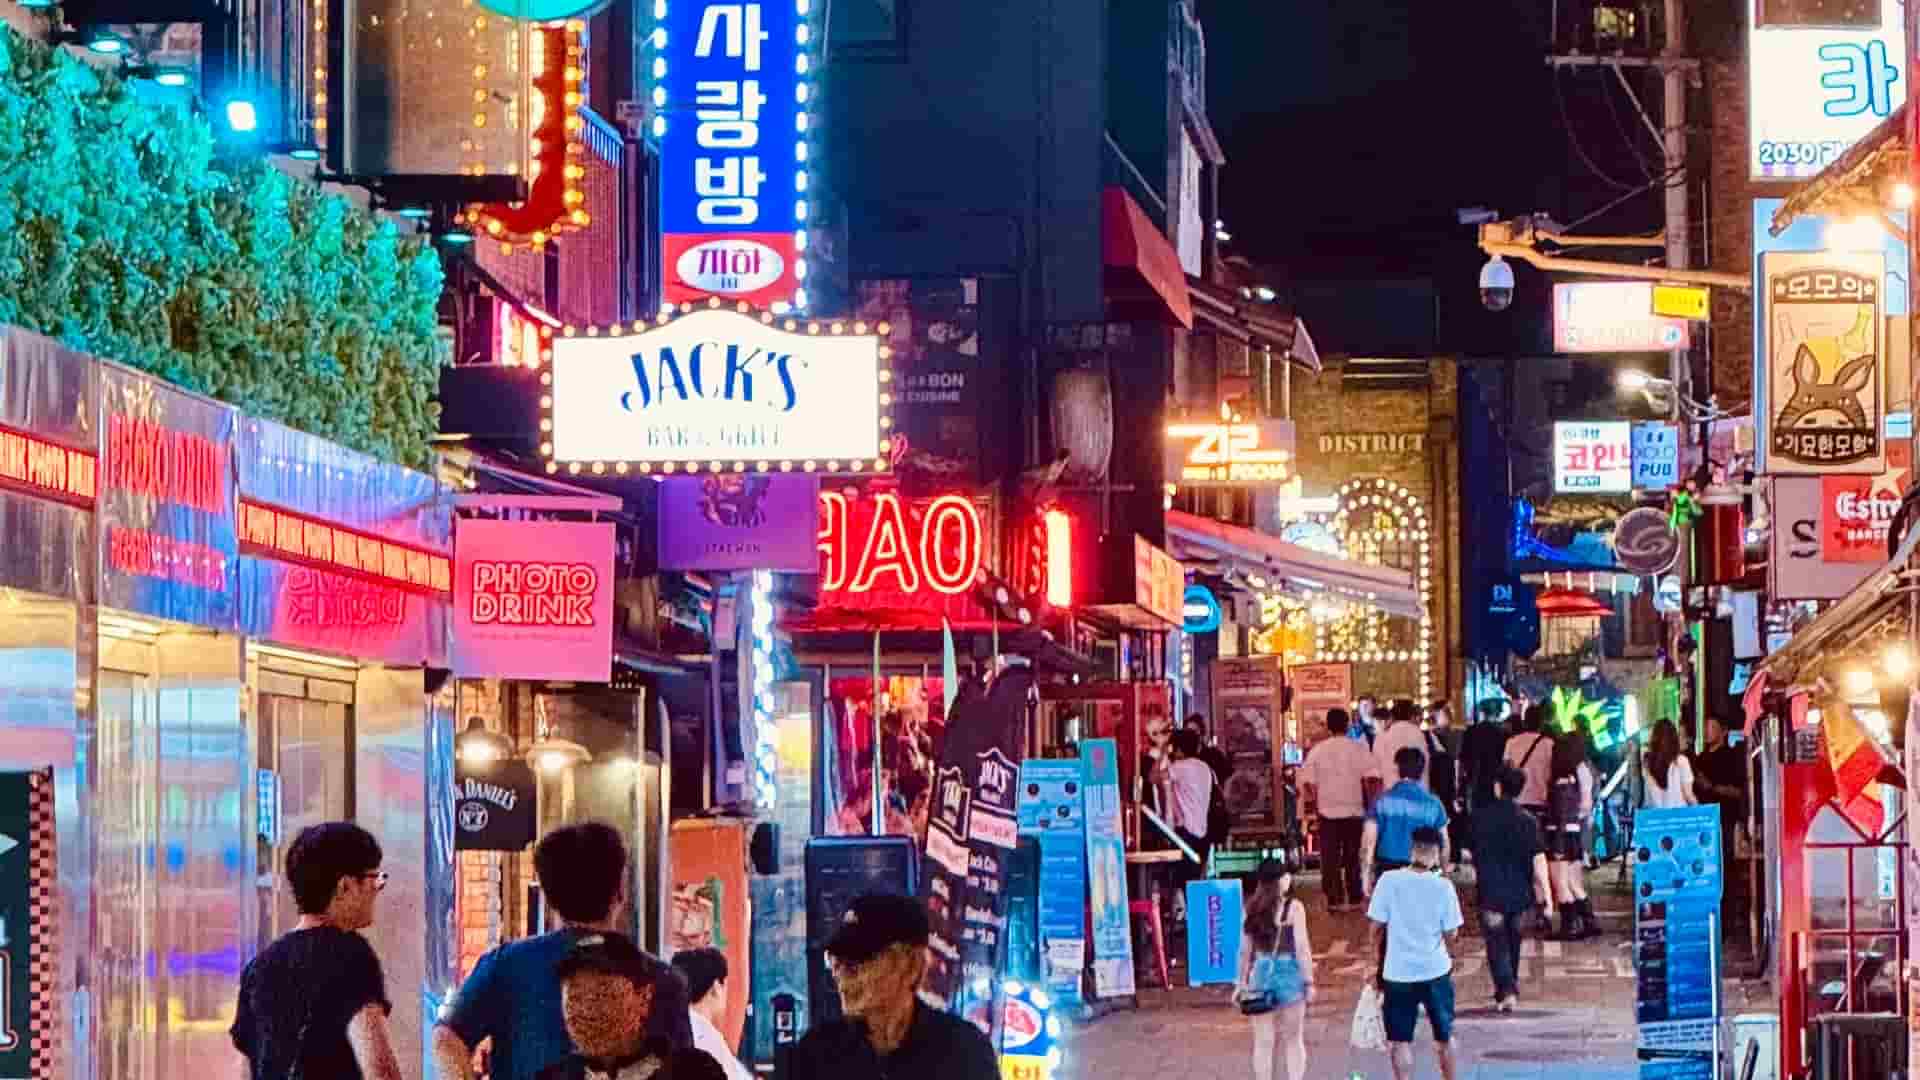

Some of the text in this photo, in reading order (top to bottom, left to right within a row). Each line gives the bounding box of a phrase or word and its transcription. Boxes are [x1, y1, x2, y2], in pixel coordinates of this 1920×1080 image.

[1818, 39, 1899, 117] 카
[694, 3, 768, 224] 사랑방
[620, 341, 809, 413] JACK'S
[1319, 434, 1425, 455] DISTRICT
[473, 561, 597, 596] PHOTO
[472, 592, 593, 626] DRINK
